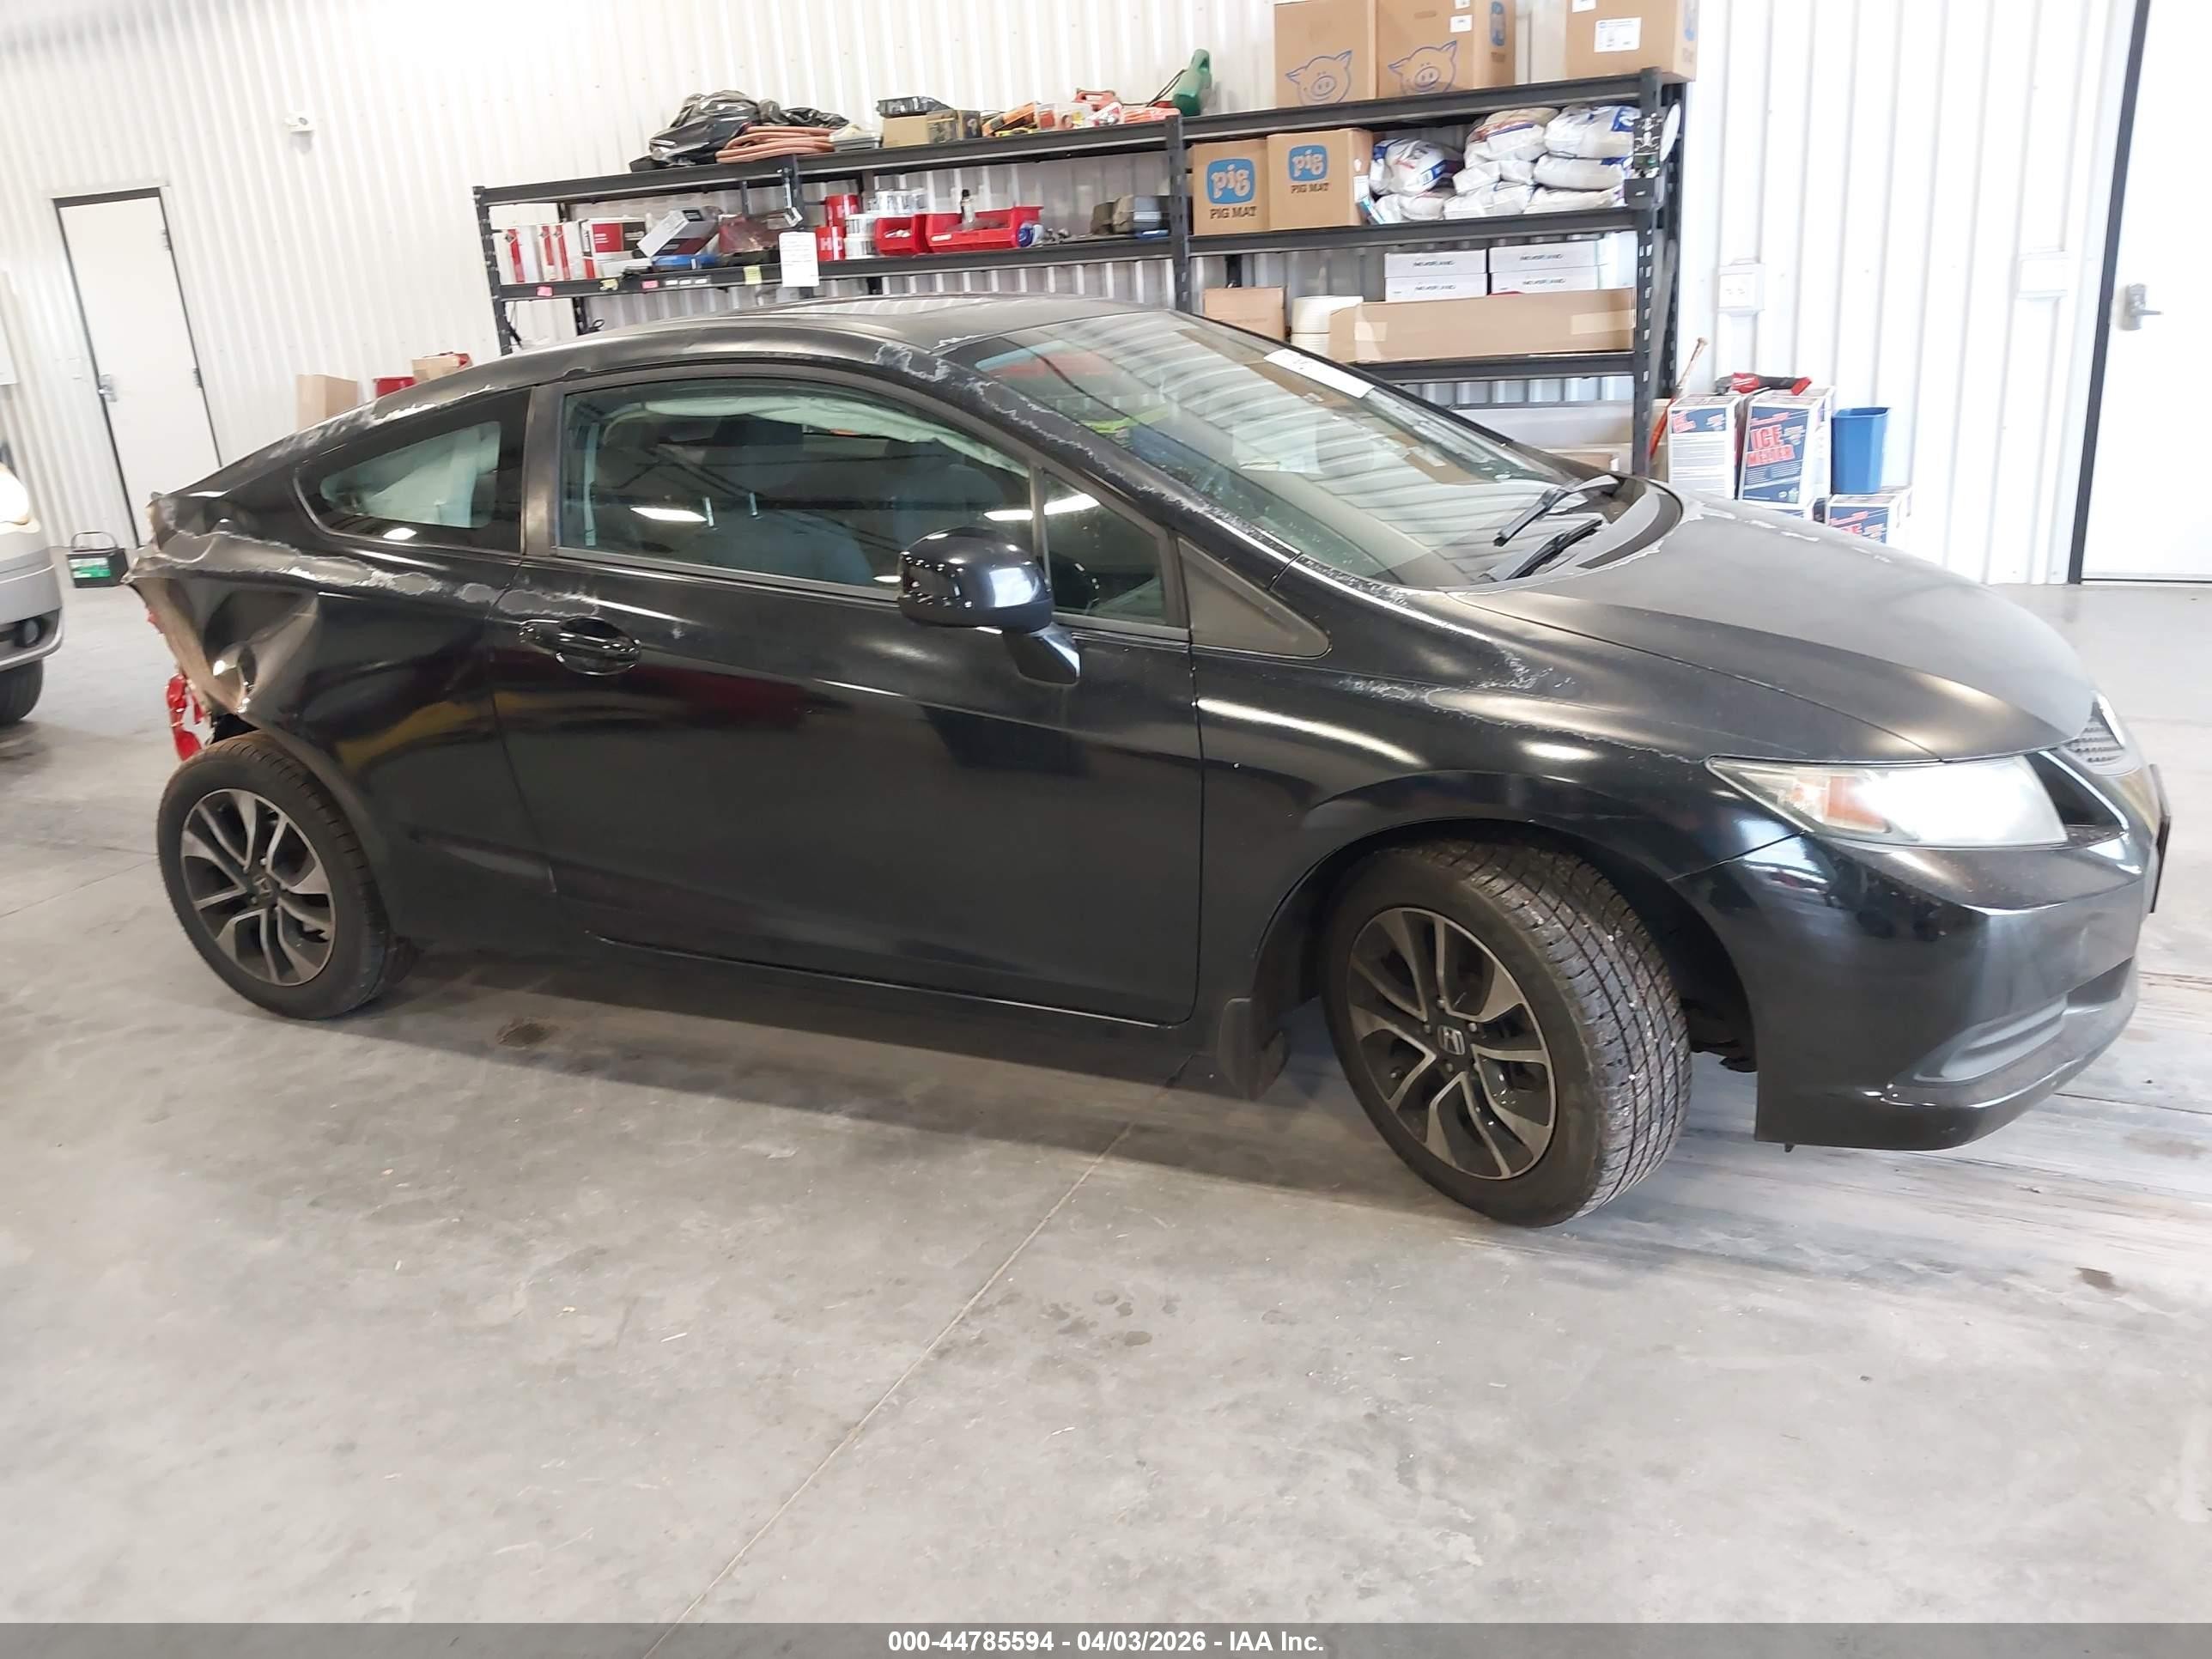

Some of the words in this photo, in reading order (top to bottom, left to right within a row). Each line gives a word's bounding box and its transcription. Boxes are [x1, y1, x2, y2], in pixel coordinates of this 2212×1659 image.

[1291, 149, 1324, 177] pig
[1211, 164, 1251, 199] pig
[1291, 184, 1307, 194] PIG
[1309, 182, 1329, 192] MAT
[1210, 208, 1230, 219] PIG
[1232, 206, 1257, 217] MAT
[1751, 424, 1784, 450] ICE
